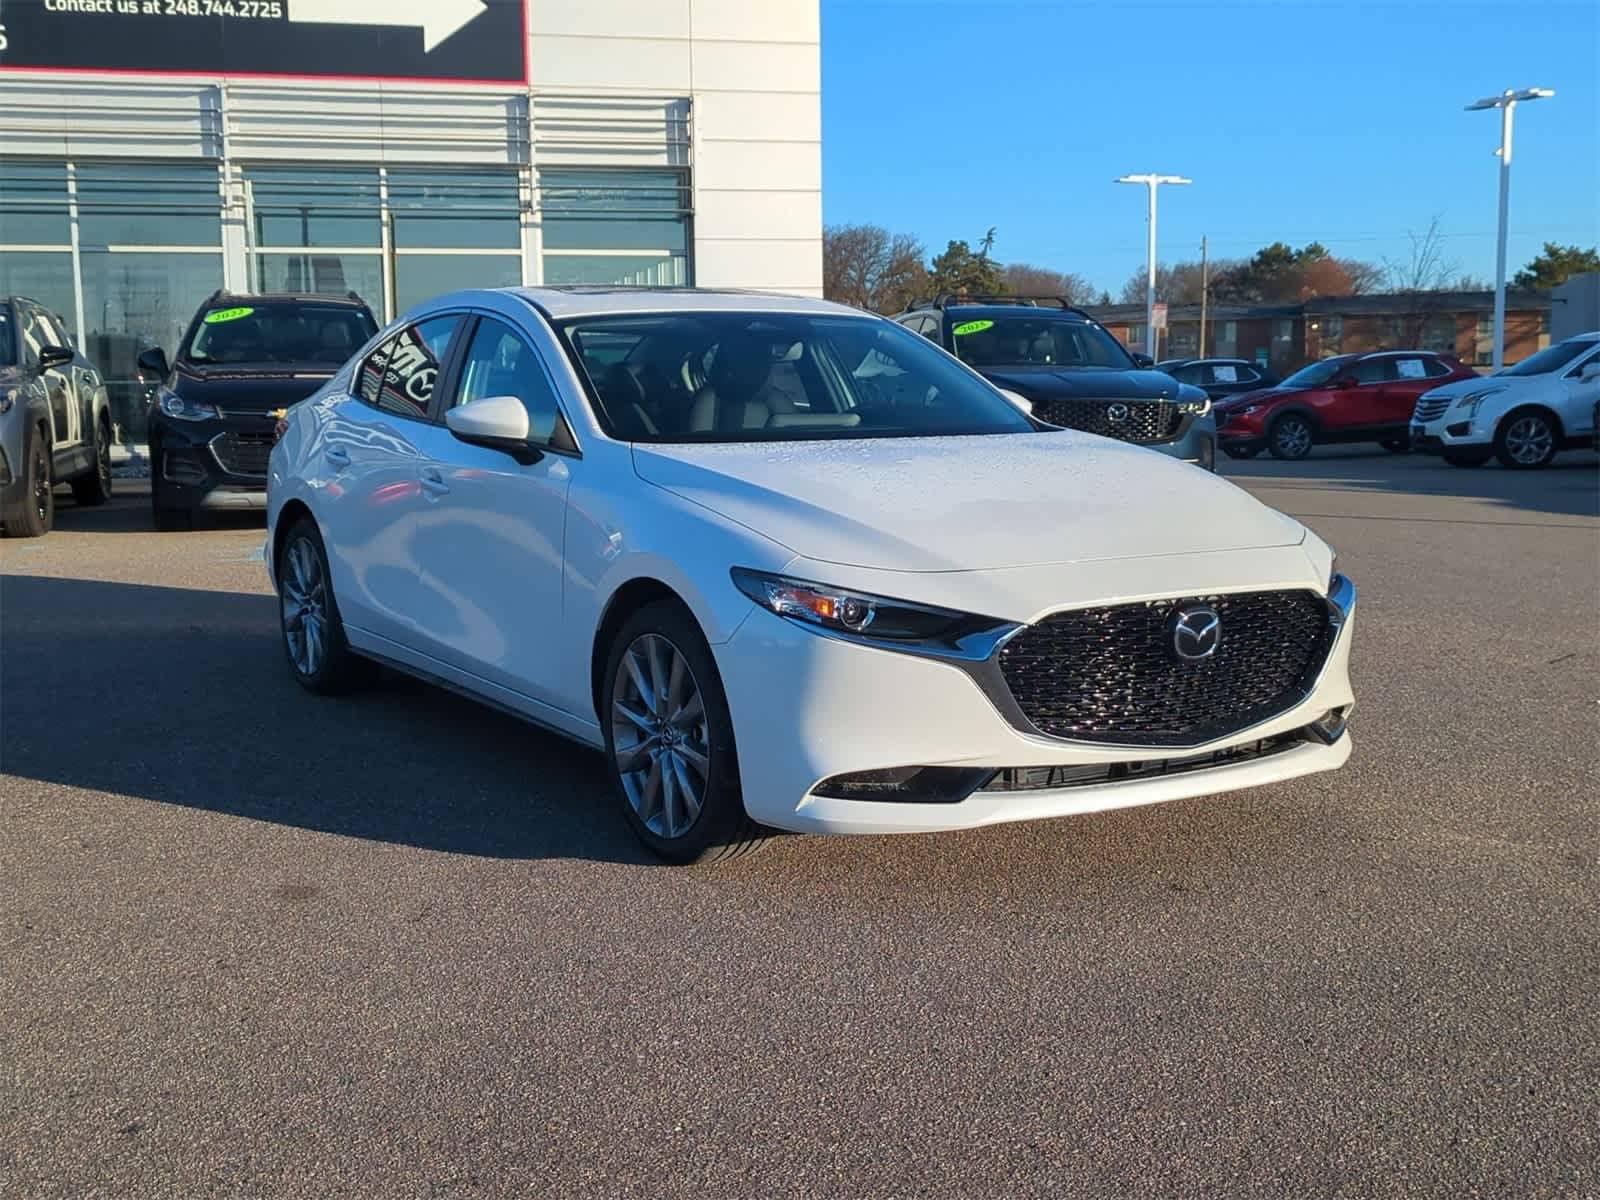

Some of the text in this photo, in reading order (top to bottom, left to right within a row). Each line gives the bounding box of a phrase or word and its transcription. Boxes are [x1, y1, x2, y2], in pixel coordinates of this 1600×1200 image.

[45, 0, 282, 18] Contact us at 248.744.2725
